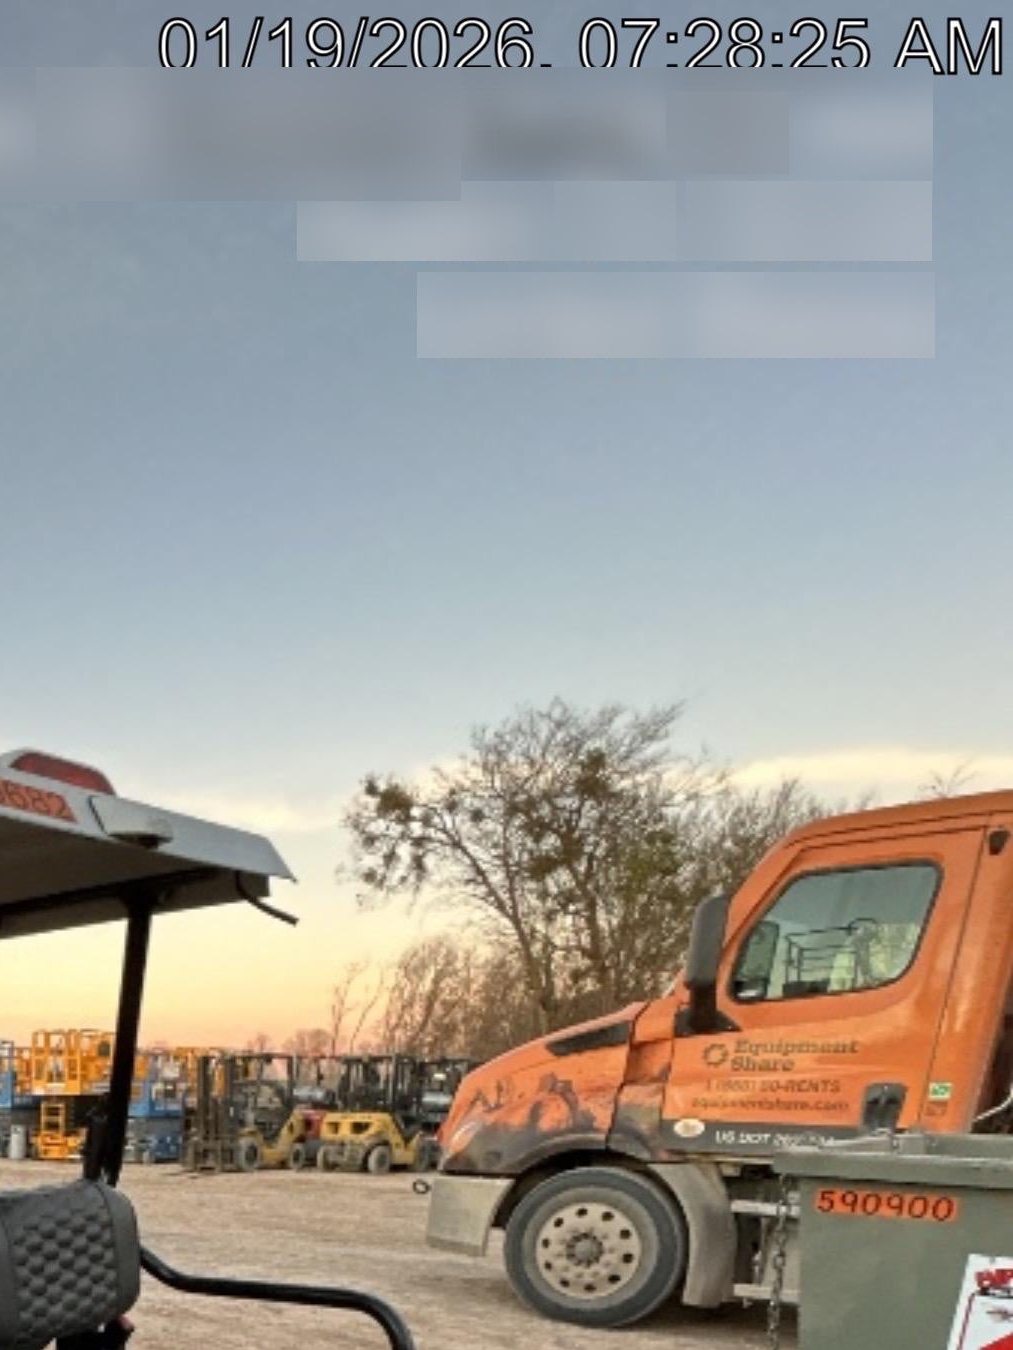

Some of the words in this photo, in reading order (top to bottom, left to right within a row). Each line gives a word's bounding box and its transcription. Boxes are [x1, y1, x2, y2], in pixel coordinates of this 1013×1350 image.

[733, 1038, 860, 1057] Equipment
[731, 1056, 795, 1072] Share
[817, 1189, 955, 1222] 590900
